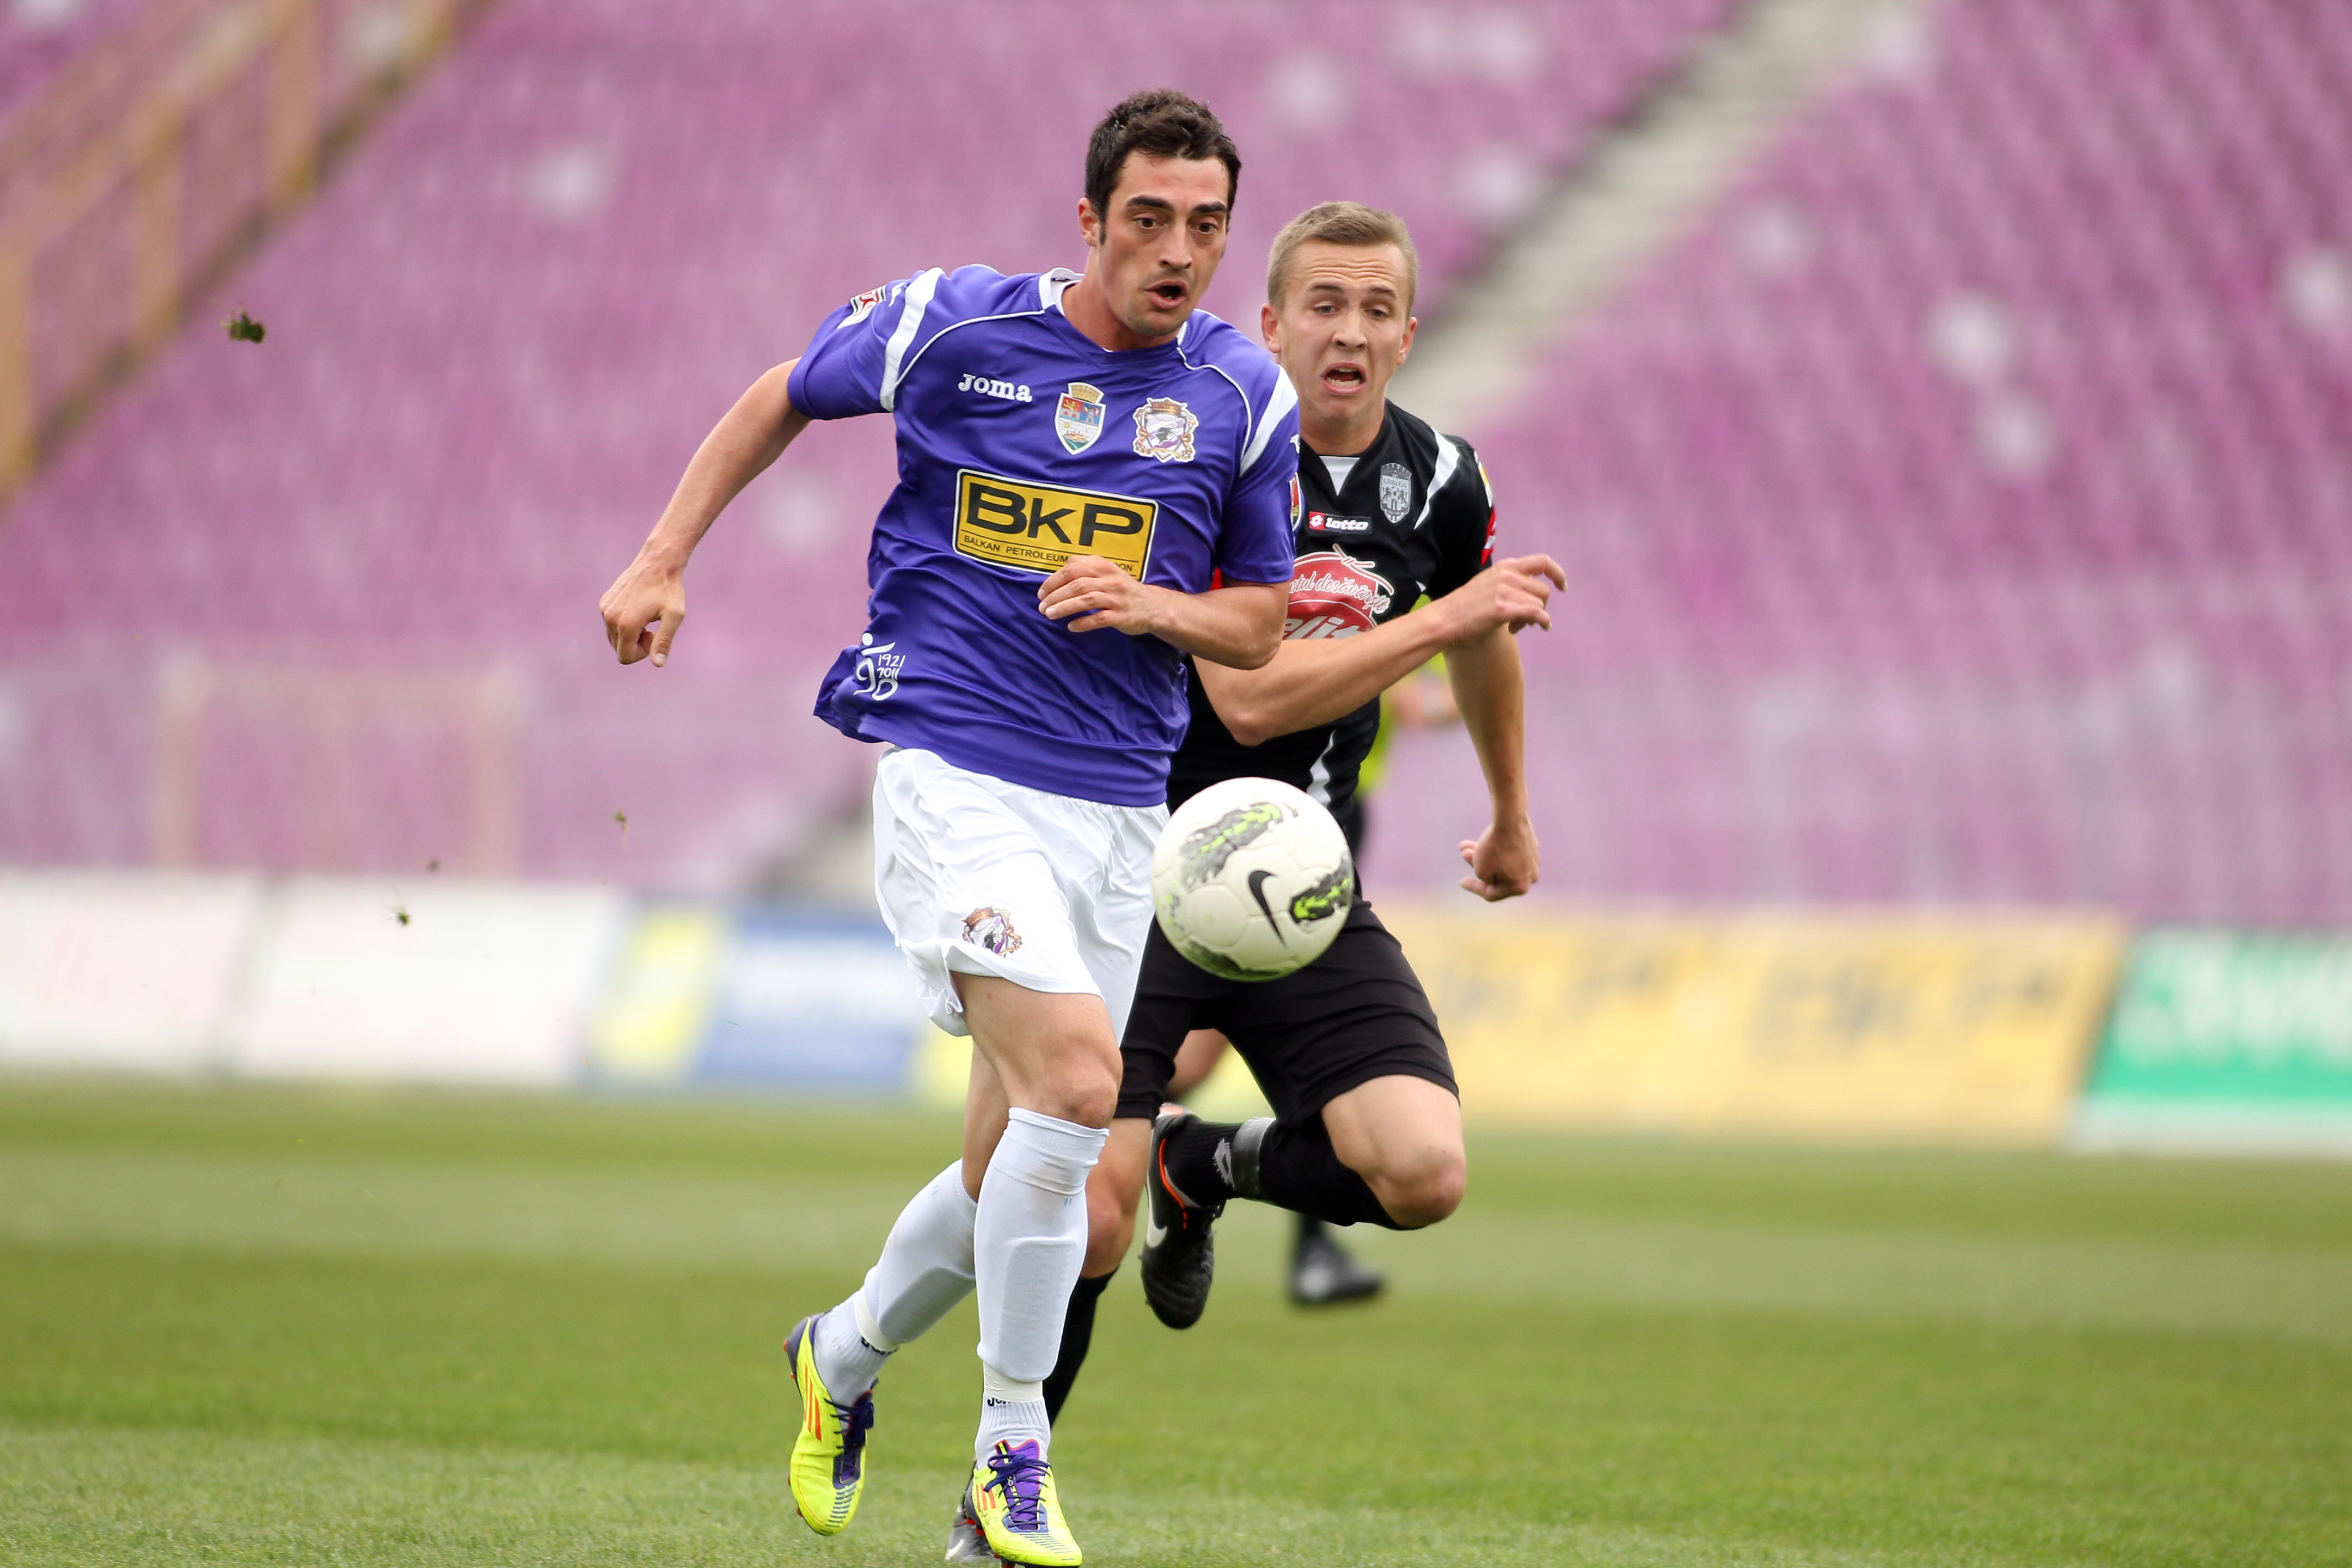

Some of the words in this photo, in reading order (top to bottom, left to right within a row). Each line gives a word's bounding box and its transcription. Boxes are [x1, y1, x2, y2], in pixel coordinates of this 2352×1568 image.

[958, 373, 1033, 403] Joma
[966, 482, 1144, 547] BKP
[1325, 517, 1369, 530] lotto
[964, 535, 1000, 552] BALKAN
[1006, 546, 1069, 563] PETROLEUM
[878, 653, 906, 668] 1921
[876, 667, 901, 680] 2011
